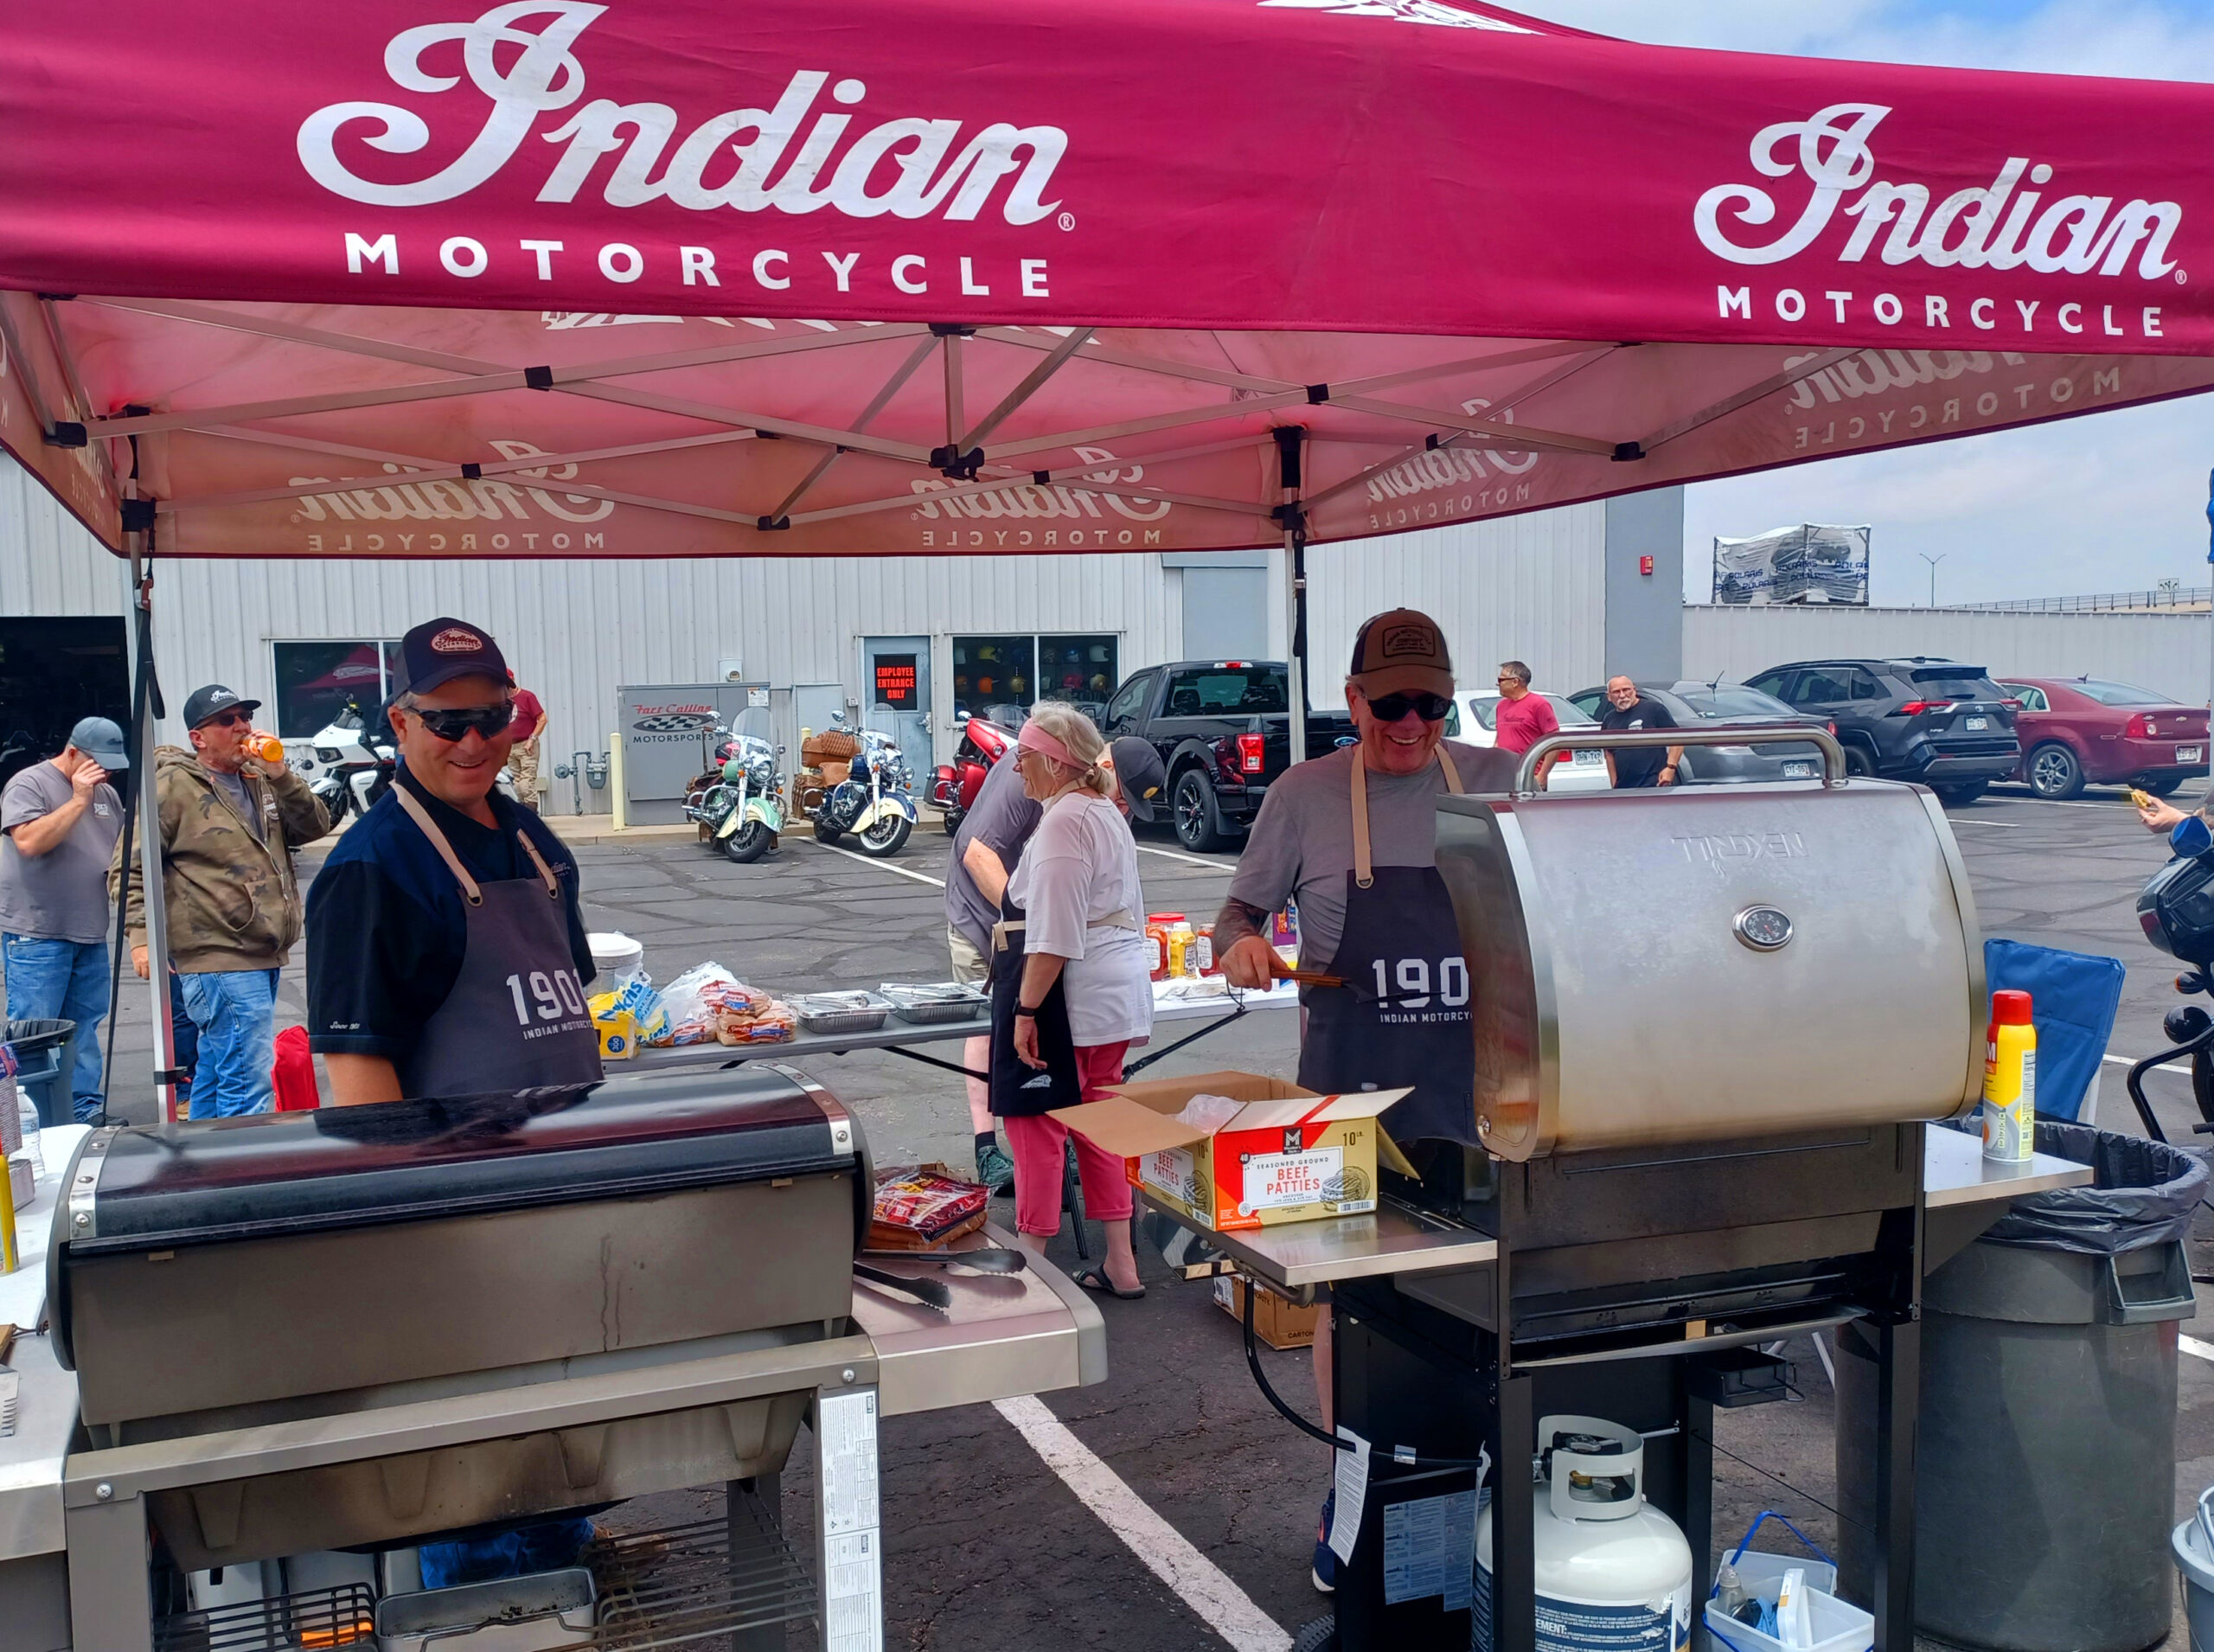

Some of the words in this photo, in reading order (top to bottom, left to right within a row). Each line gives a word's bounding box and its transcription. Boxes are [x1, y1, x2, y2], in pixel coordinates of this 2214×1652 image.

[297, 1, 1069, 227] Indian
[1693, 103, 2183, 280] Indian
[344, 232, 1051, 298] MOTORCYCLE
[1717, 285, 2165, 337] MOTORCYCLE
[877, 667, 914, 676] EMPLOYEE
[877, 678, 914, 688] ENTRANCE
[886, 689, 905, 699] ONLY
[1379, 1013, 1417, 1024] INDIAN
[1421, 1010, 1474, 1023] MOTORCY
[523, 1023, 560, 1041] INDIAN
[1342, 1132, 1357, 1147] 10
[1158, 1152, 1174, 1170] BEEF
[1257, 1160, 1296, 1170] SEASONED
[1298, 1156, 1329, 1166] GROUND
[1154, 1162, 1180, 1186] PATTIES
[1277, 1166, 1309, 1181] BEEF
[1266, 1178, 1321, 1196] PATTIES
